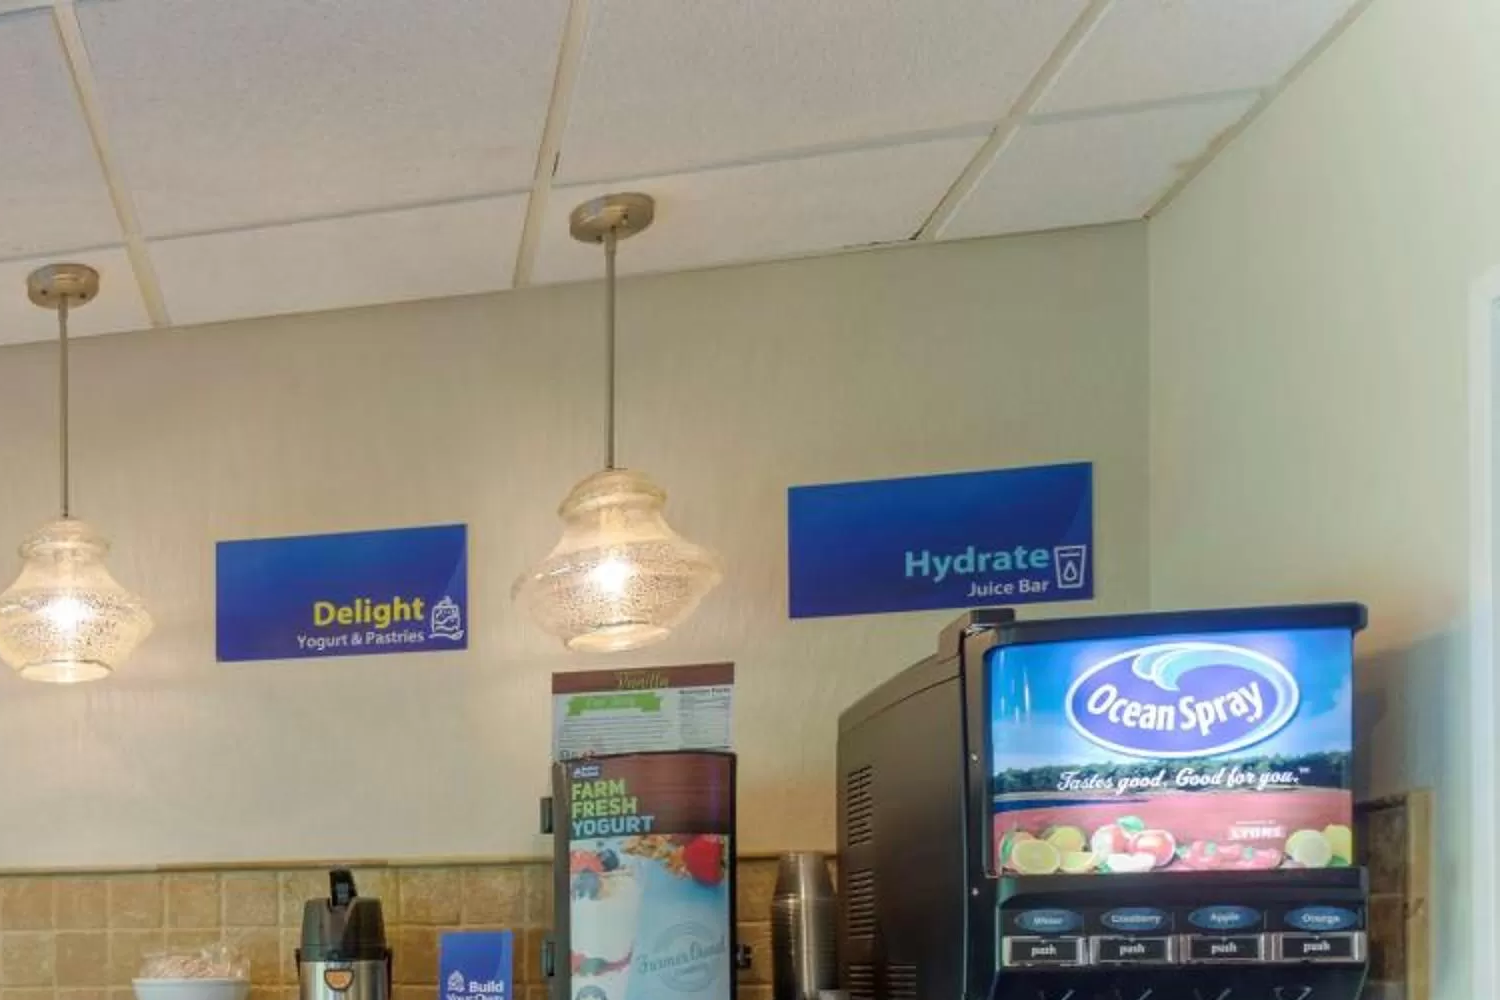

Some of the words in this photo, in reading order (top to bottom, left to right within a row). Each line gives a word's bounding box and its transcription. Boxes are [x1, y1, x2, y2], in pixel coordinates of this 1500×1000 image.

[904, 545, 1050, 583] Hydrate
[967, 580, 1014, 598] Juice
[1019, 578, 1050, 594] Bar
[313, 595, 425, 629] Delight
[297, 633, 348, 651] Yogurt
[351, 631, 363, 646] &
[365, 629, 425, 646] Pastries
[1087, 683, 1175, 732] Ocean
[1179, 680, 1264, 737] Spray
[1057, 771, 1114, 791] Tastes
[1175, 767, 1223, 788] Good
[1226, 764, 1256, 787] for
[572, 779, 625, 801] FARM
[572, 796, 639, 819] FRESH
[572, 815, 655, 837] YOGURT
[1031, 943, 1057, 958] push
[1119, 942, 1146, 957] push
[1211, 941, 1238, 955] push
[1303, 939, 1331, 953] push
[469, 979, 505, 993] Build
